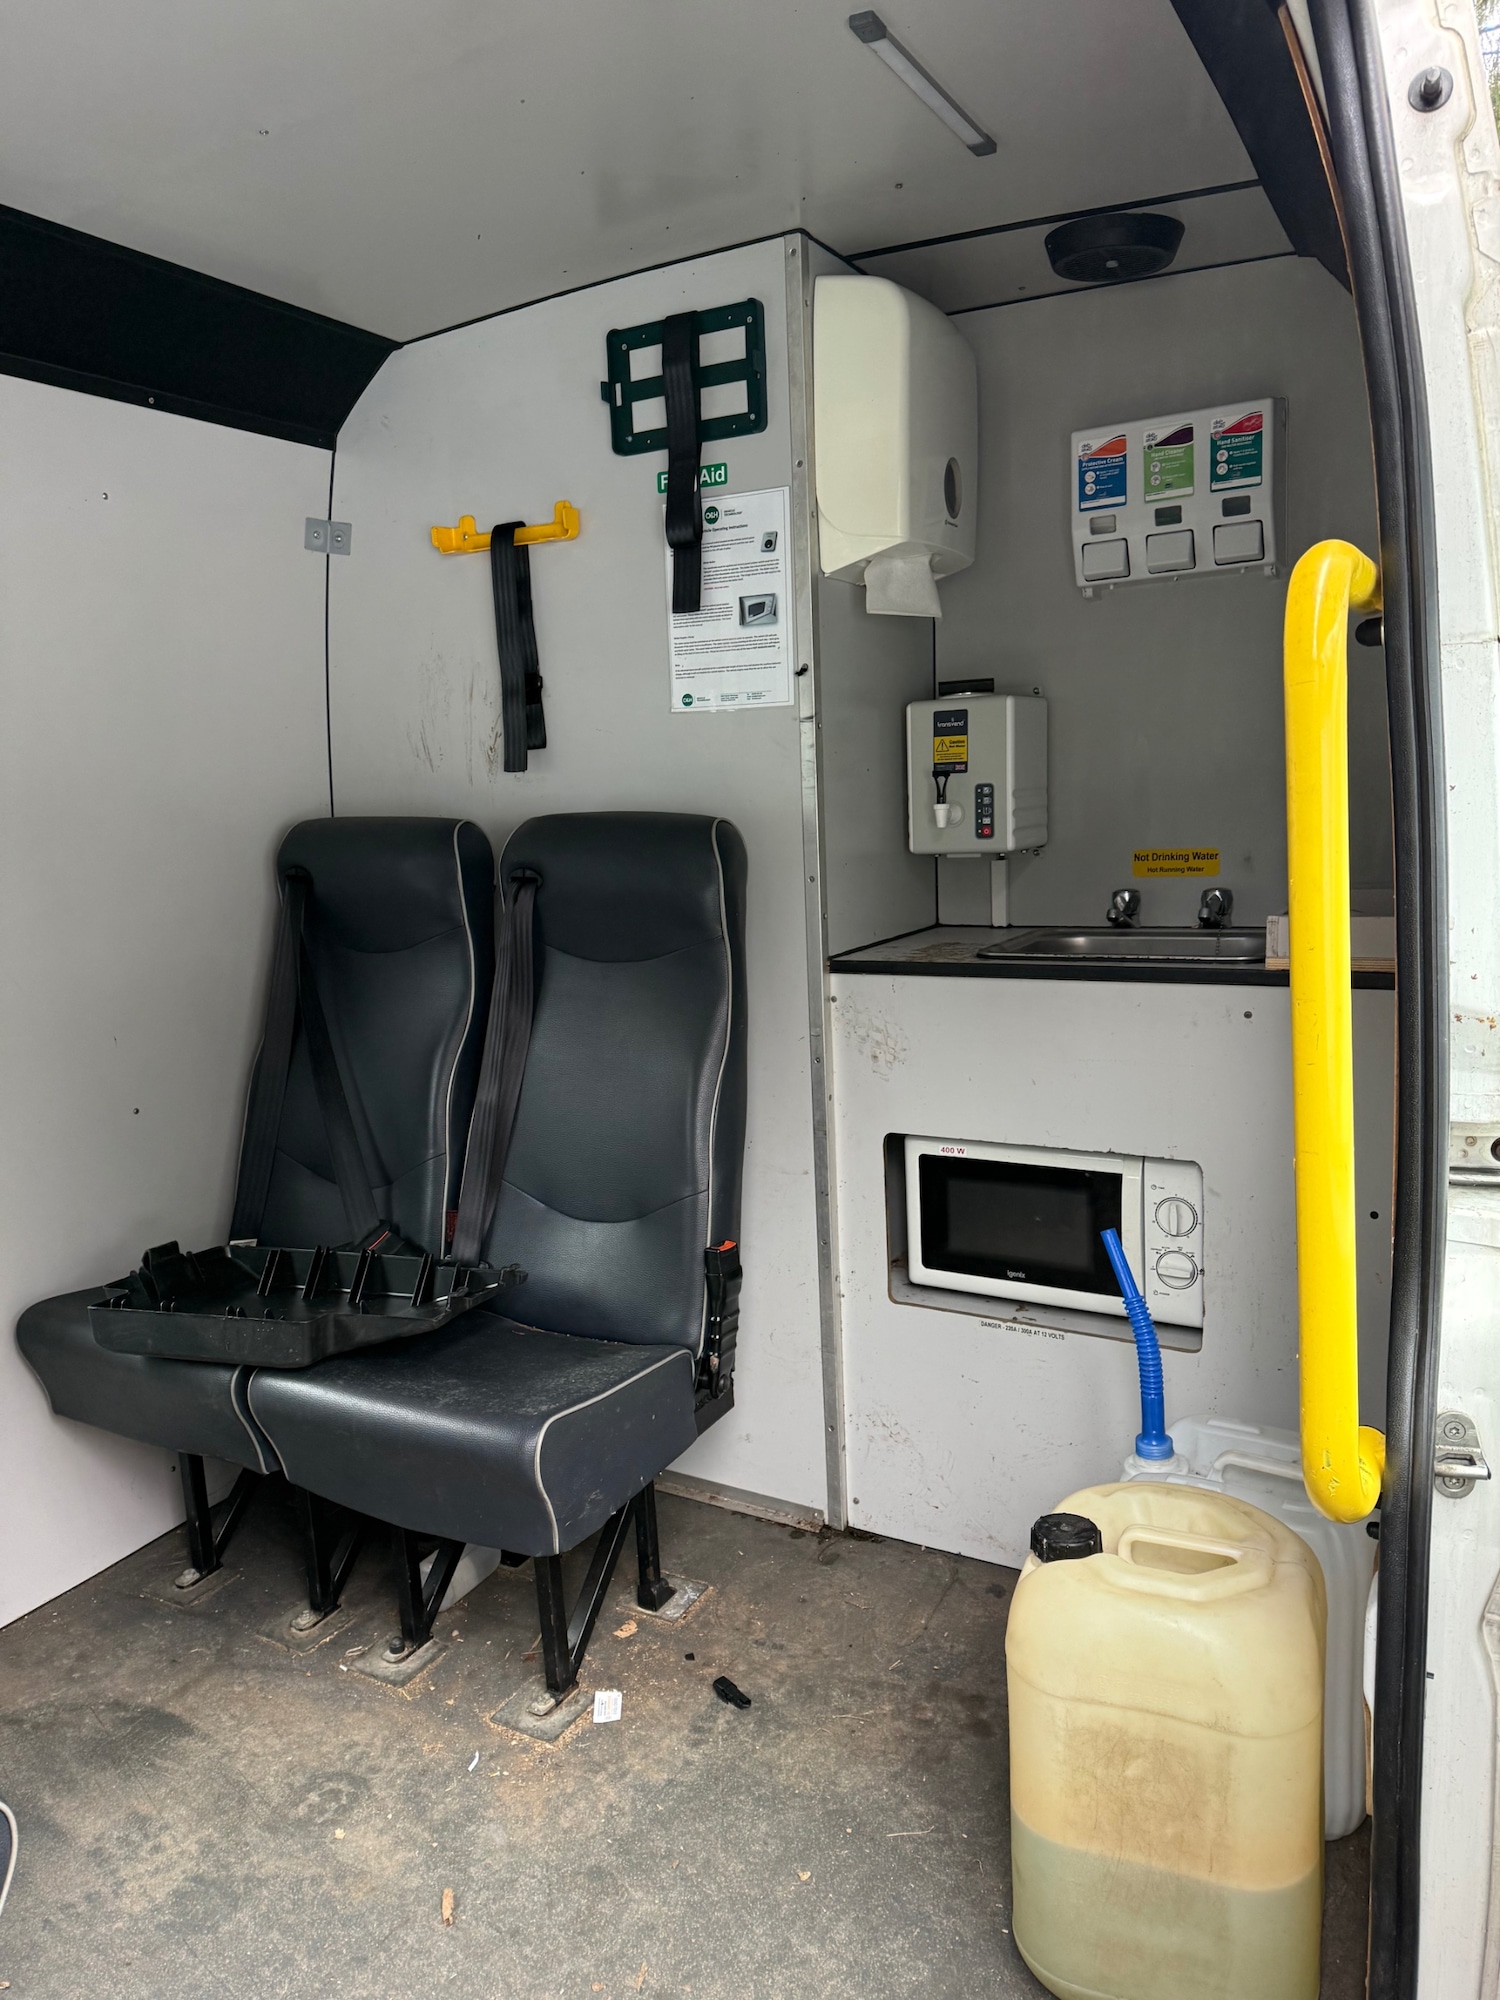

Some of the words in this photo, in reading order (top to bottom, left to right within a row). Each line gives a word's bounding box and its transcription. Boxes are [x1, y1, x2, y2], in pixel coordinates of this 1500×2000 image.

[1082, 459, 1107, 468] Protective
[1107, 456, 1124, 464] Cream
[700, 466, 725, 485] Aid
[1134, 853, 1149, 862] Not
[1151, 852, 1190, 863] Drinking
[1191, 851, 1219, 861] Water
[1160, 866, 1185, 874] Running
[940, 1146, 955, 1154] 400
[956, 1147, 966, 1155] W
[980, 1320, 1002, 1330] DANGER
[1048, 1332, 1065, 1340] VOLTS
